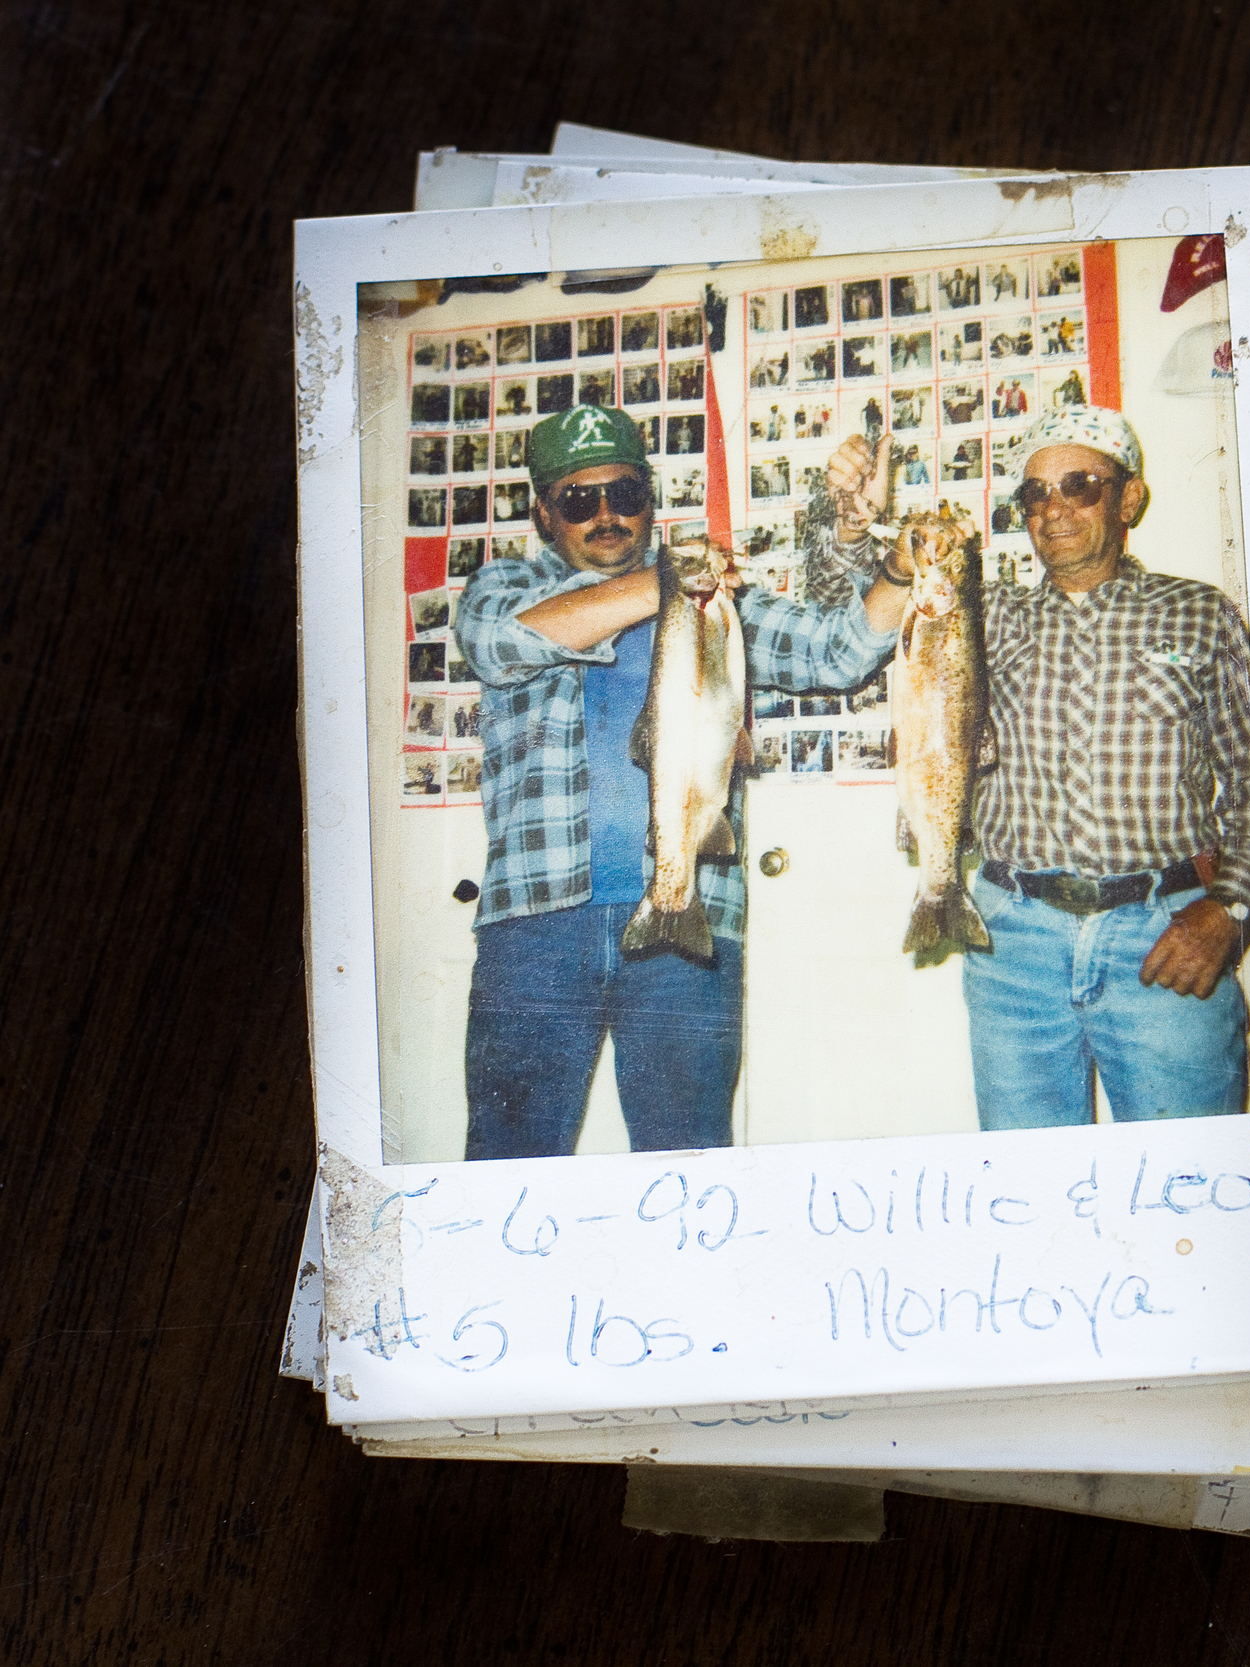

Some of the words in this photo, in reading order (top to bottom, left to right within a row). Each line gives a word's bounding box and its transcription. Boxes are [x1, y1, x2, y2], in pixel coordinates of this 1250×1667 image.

[1066, 1156, 1102, 1238] &
[565, 1294, 729, 1367] lbs.
[824, 1252, 1176, 1358] Montoya
